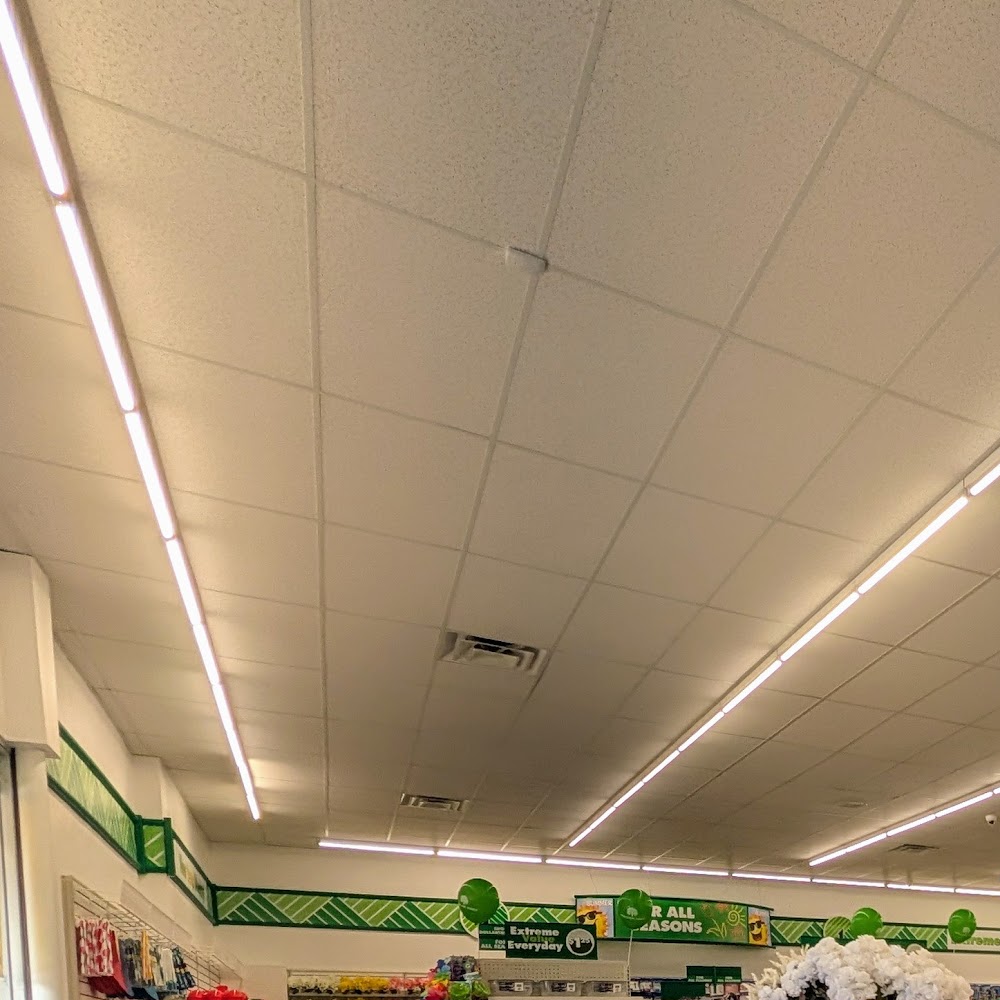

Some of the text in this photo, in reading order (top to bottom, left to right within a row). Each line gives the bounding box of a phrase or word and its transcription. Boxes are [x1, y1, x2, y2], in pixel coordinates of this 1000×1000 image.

[667, 907, 695, 919] ALL
[510, 926, 560, 937] Extreme
[507, 940, 563, 952] Everyday
